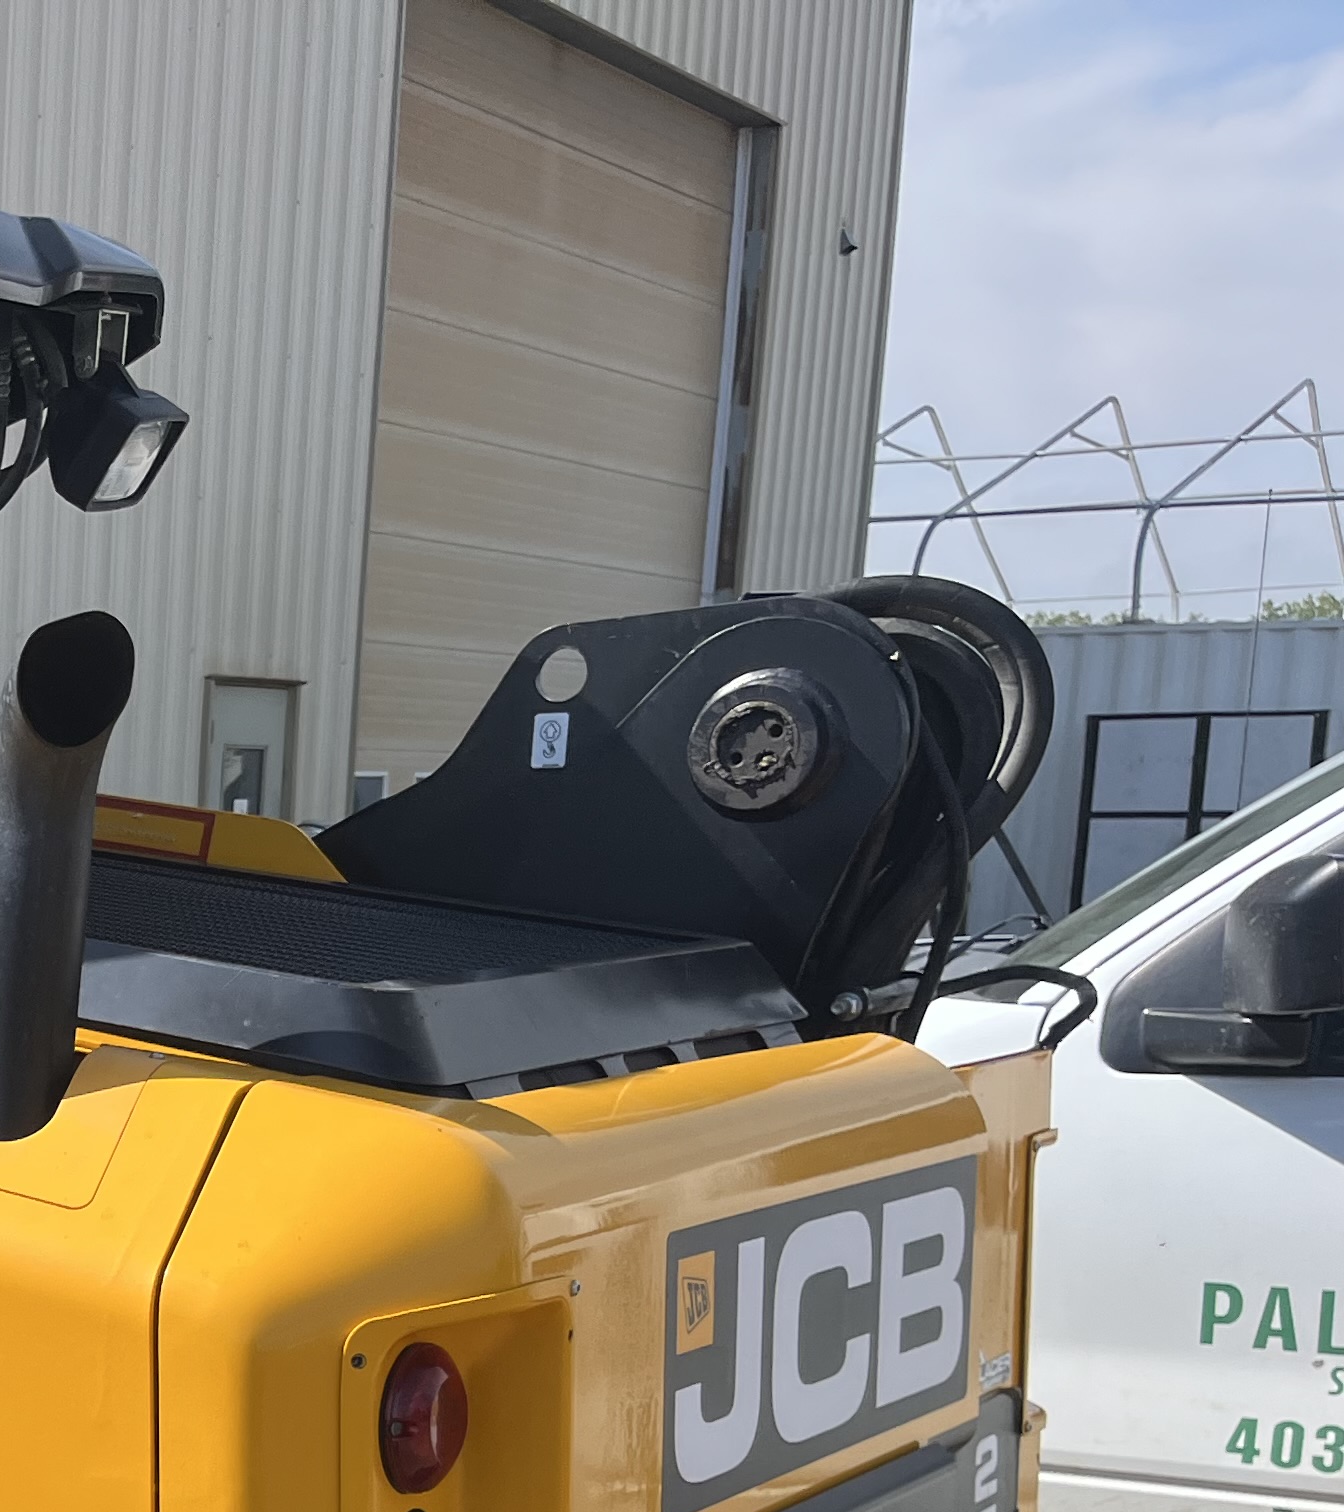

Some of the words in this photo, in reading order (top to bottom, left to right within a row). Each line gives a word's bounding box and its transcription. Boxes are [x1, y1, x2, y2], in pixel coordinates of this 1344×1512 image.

[673, 1185, 966, 1485] JCB
[686, 1281, 709, 1327] JCB
[1199, 1281, 1344, 1356] PAL
[1225, 1417, 1344, 1474] 403
